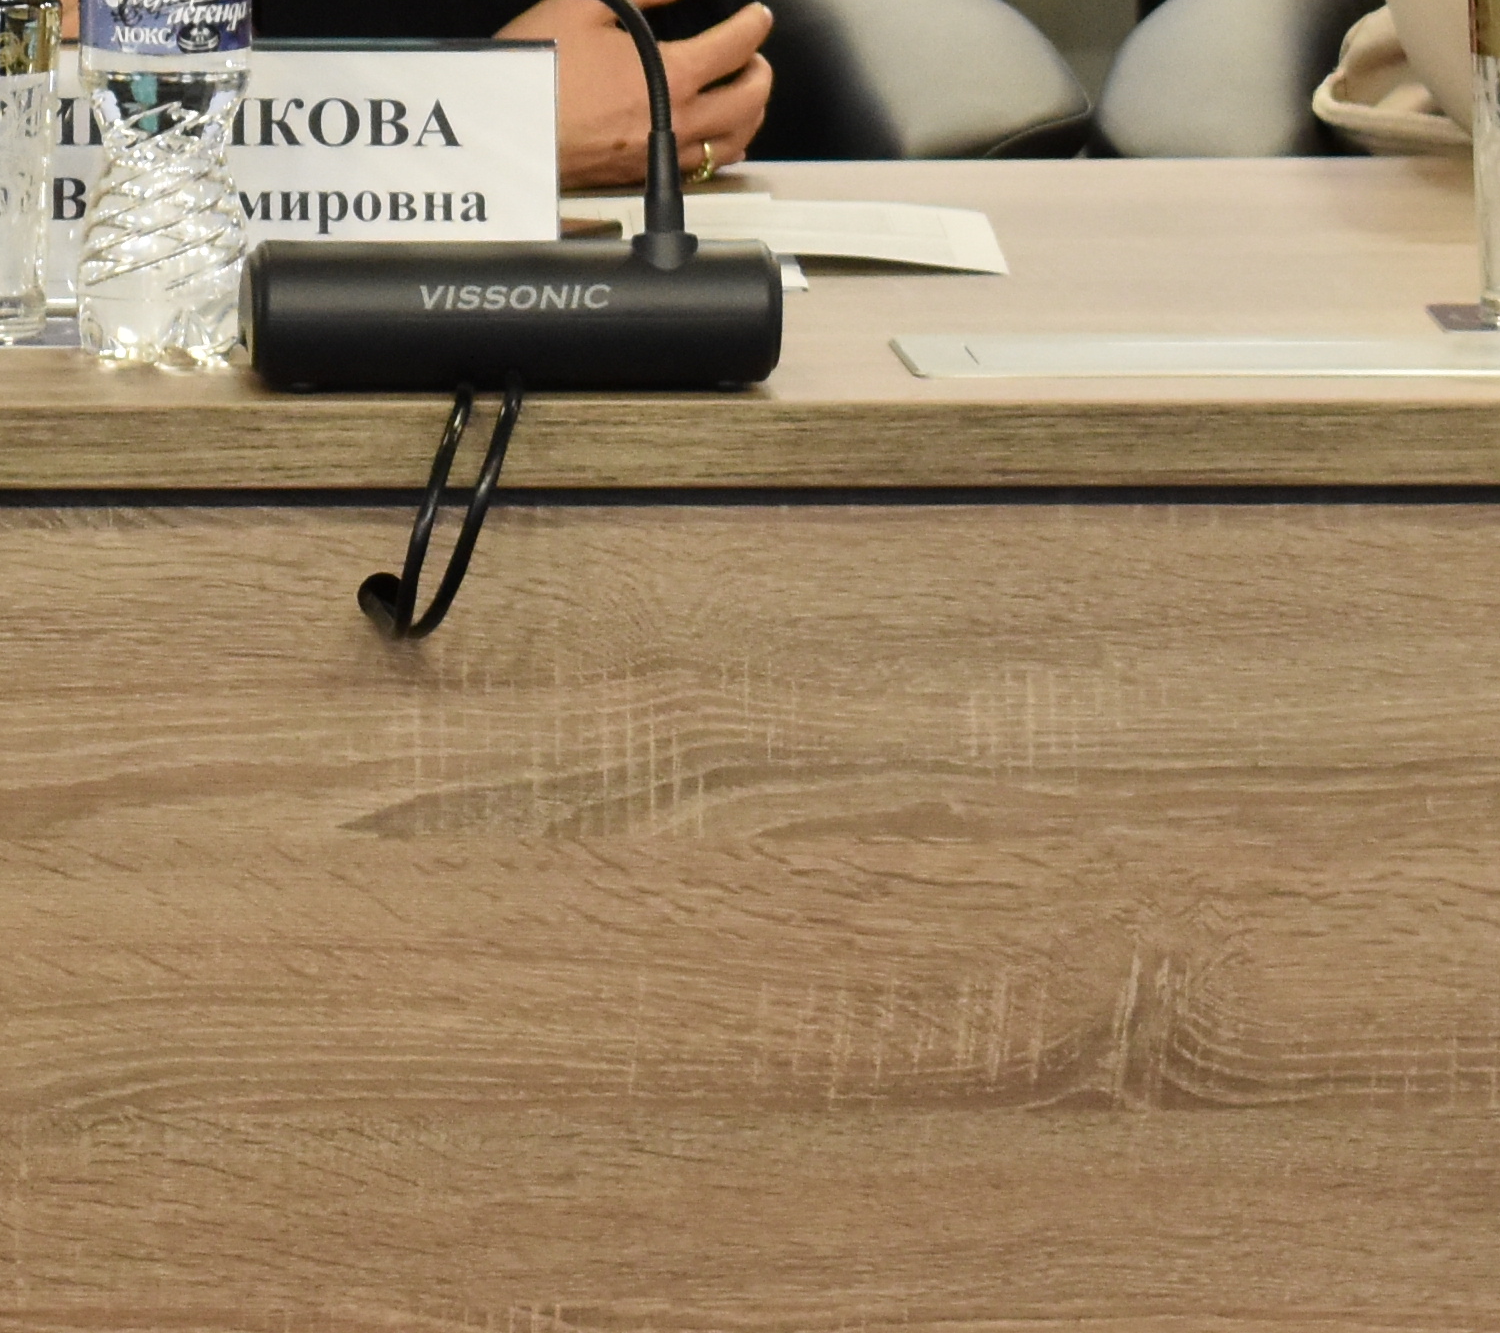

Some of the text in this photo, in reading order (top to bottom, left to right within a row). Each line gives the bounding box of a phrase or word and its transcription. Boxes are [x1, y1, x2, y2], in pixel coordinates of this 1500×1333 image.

[111, 25, 172, 45] ЛЮКС
[51, 176, 488, 235] Вмировна
[419, 283, 612, 311] VISSONIC
